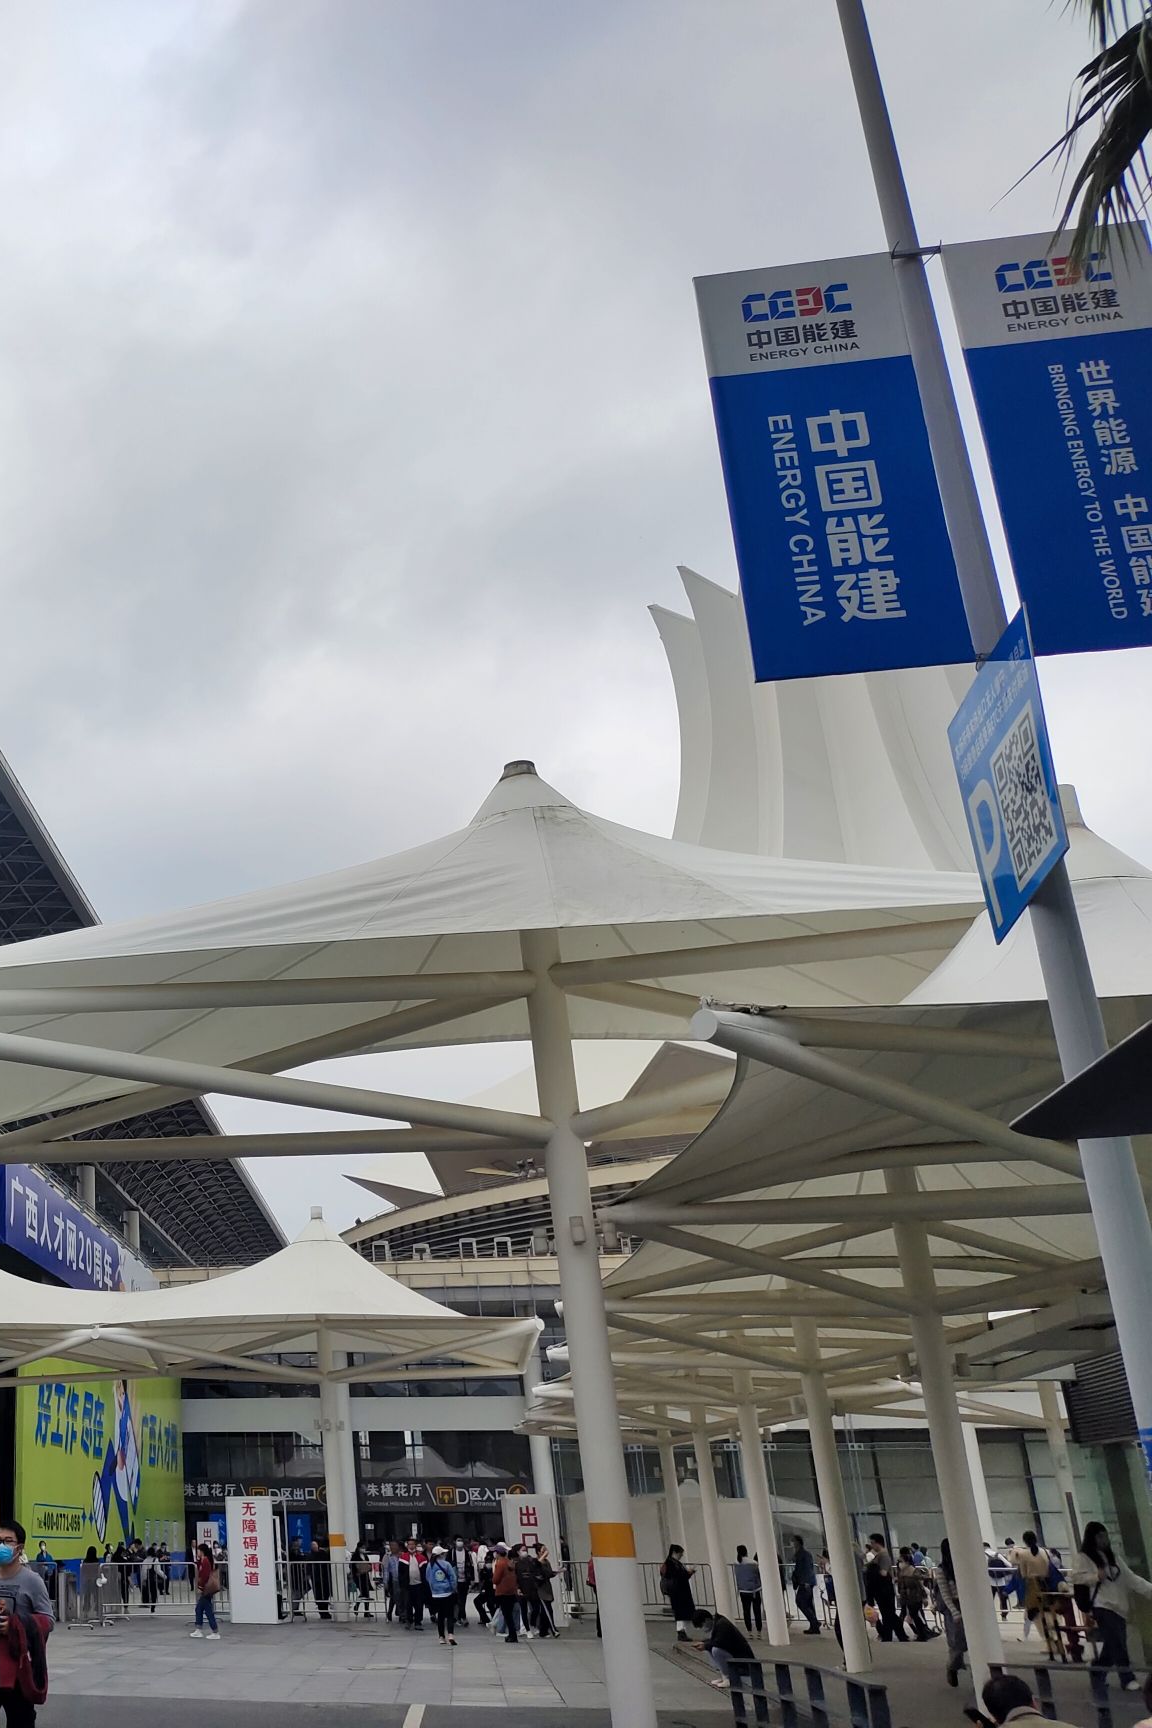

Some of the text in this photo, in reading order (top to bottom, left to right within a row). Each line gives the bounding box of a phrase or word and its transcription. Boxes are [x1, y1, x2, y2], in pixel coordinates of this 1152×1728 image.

[747, 319, 858, 349] 中国能建
[750, 342, 860, 362] ENERGY CHINA
[1002, 288, 1120, 319] 中国能建
[1007, 311, 1123, 332] ENERGY CHINA
[1076, 360, 1139, 475] 世界能源
[767, 414, 826, 626] ENERGY CHINA
[806, 409, 907, 623] 中国能建
[1048, 364, 1128, 619] BRINGING ENERGY TO THE WORLD
[968, 779, 1004, 926] P
[10, 1176, 113, 1291] 广西人才网20周年
[241, 1502, 260, 1586] 无障碍通道
[519, 1505, 539, 1549] 出口
